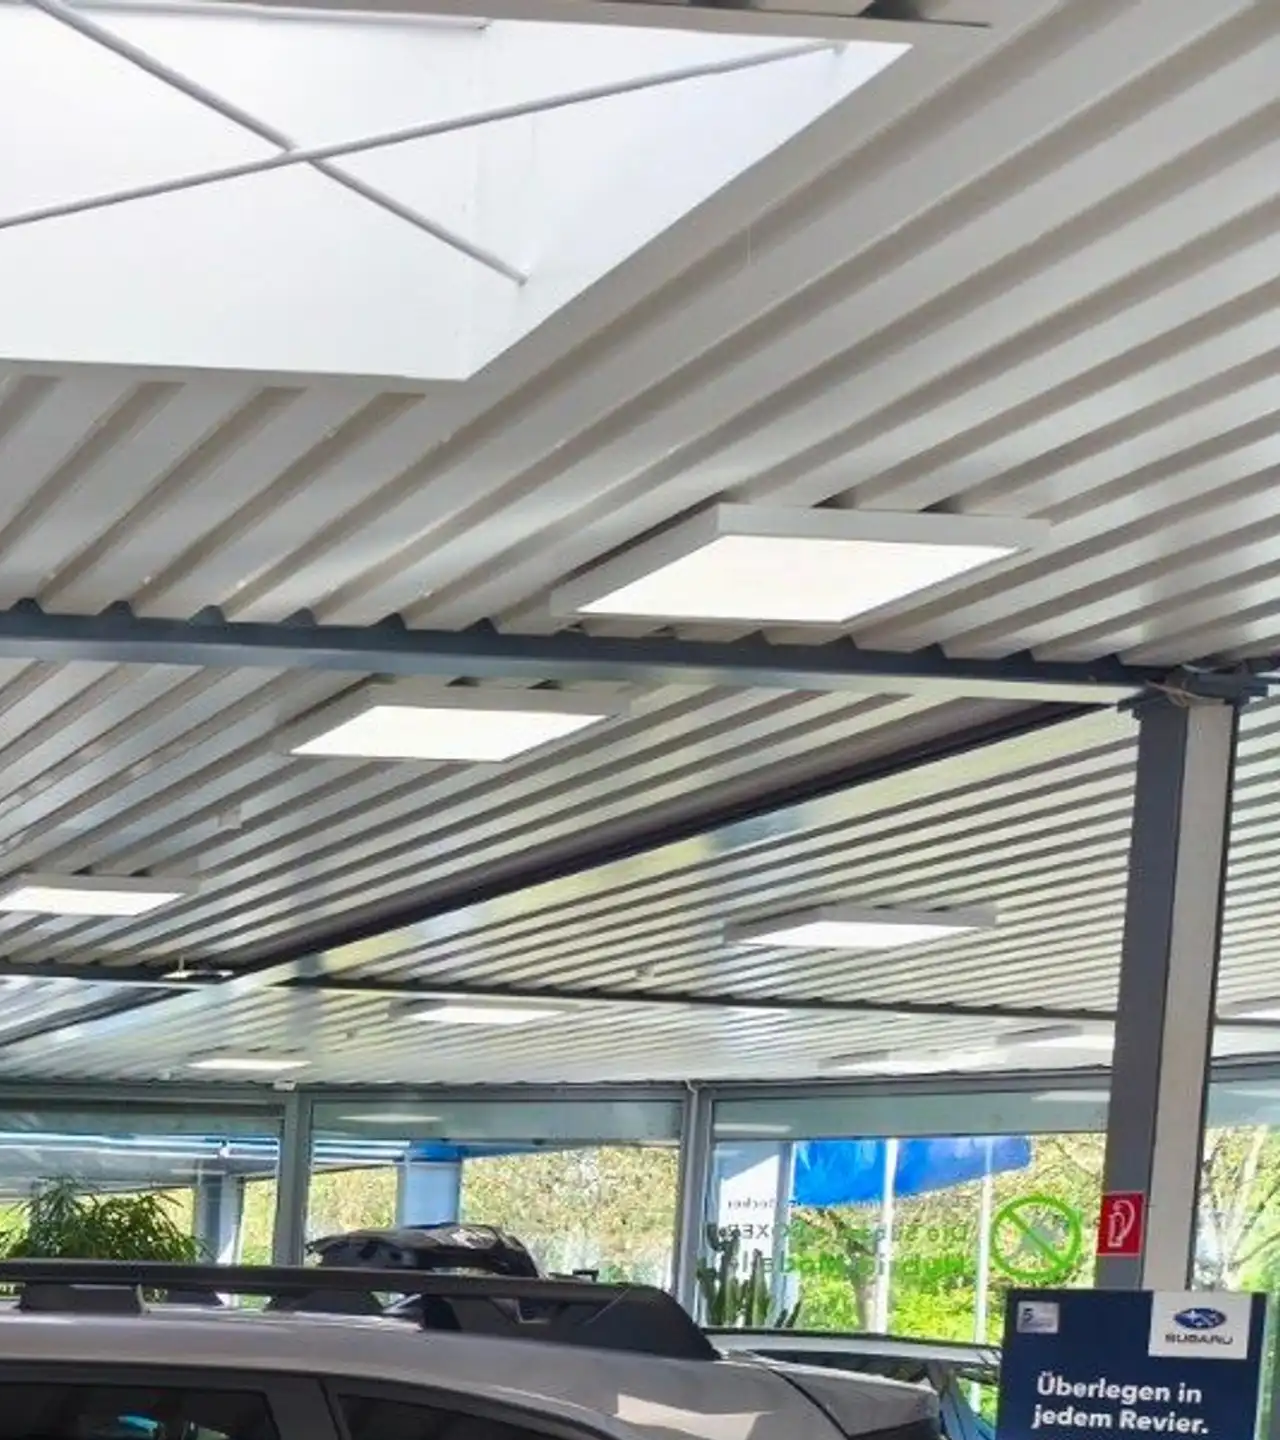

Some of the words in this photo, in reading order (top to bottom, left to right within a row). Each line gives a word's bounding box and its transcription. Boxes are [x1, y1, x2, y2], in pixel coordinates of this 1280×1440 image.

[1164, 1333, 1234, 1346] SUBARU
[1036, 1371, 1171, 1405] Überlegen
[1178, 1382, 1203, 1404] in
[1030, 1404, 1113, 1430] jedem
[1119, 1409, 1210, 1435] Revier.
